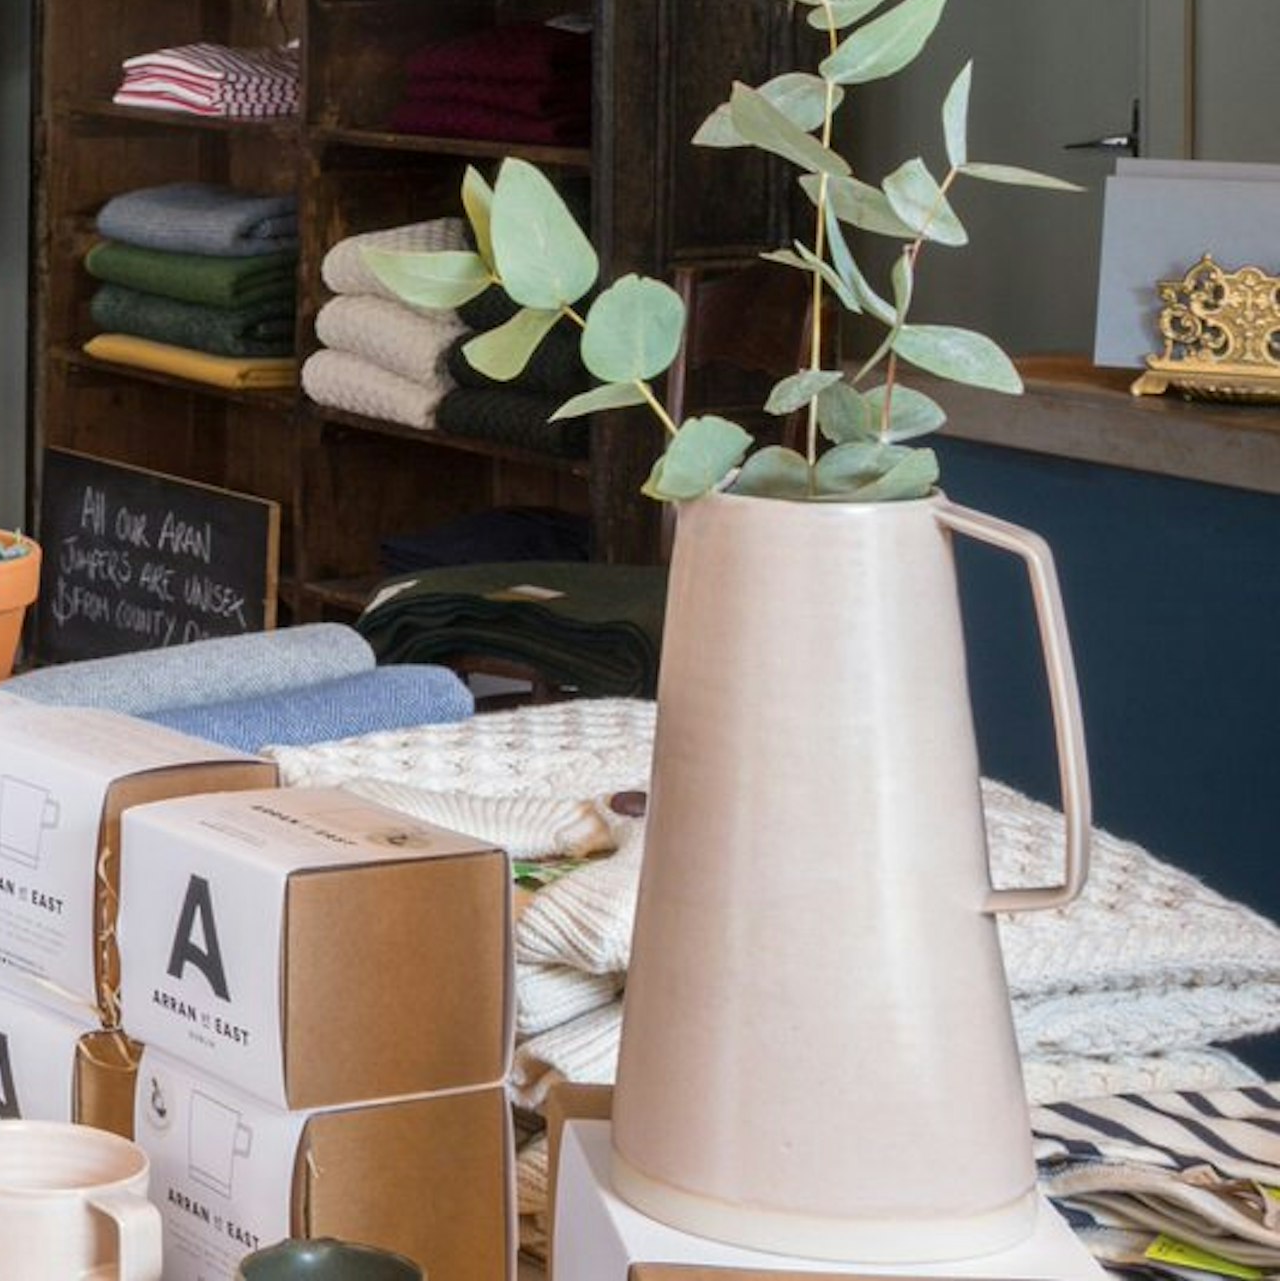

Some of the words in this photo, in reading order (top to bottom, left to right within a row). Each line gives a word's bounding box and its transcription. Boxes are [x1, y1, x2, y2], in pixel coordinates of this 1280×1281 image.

[31, 888, 64, 915] EAST
[166, 873, 231, 1003] A
[152, 989, 197, 1022] ARRAN
[214, 1018, 250, 1047] EAST
[167, 1187, 210, 1225] ARRAN
[226, 1220, 260, 1254] EAST
